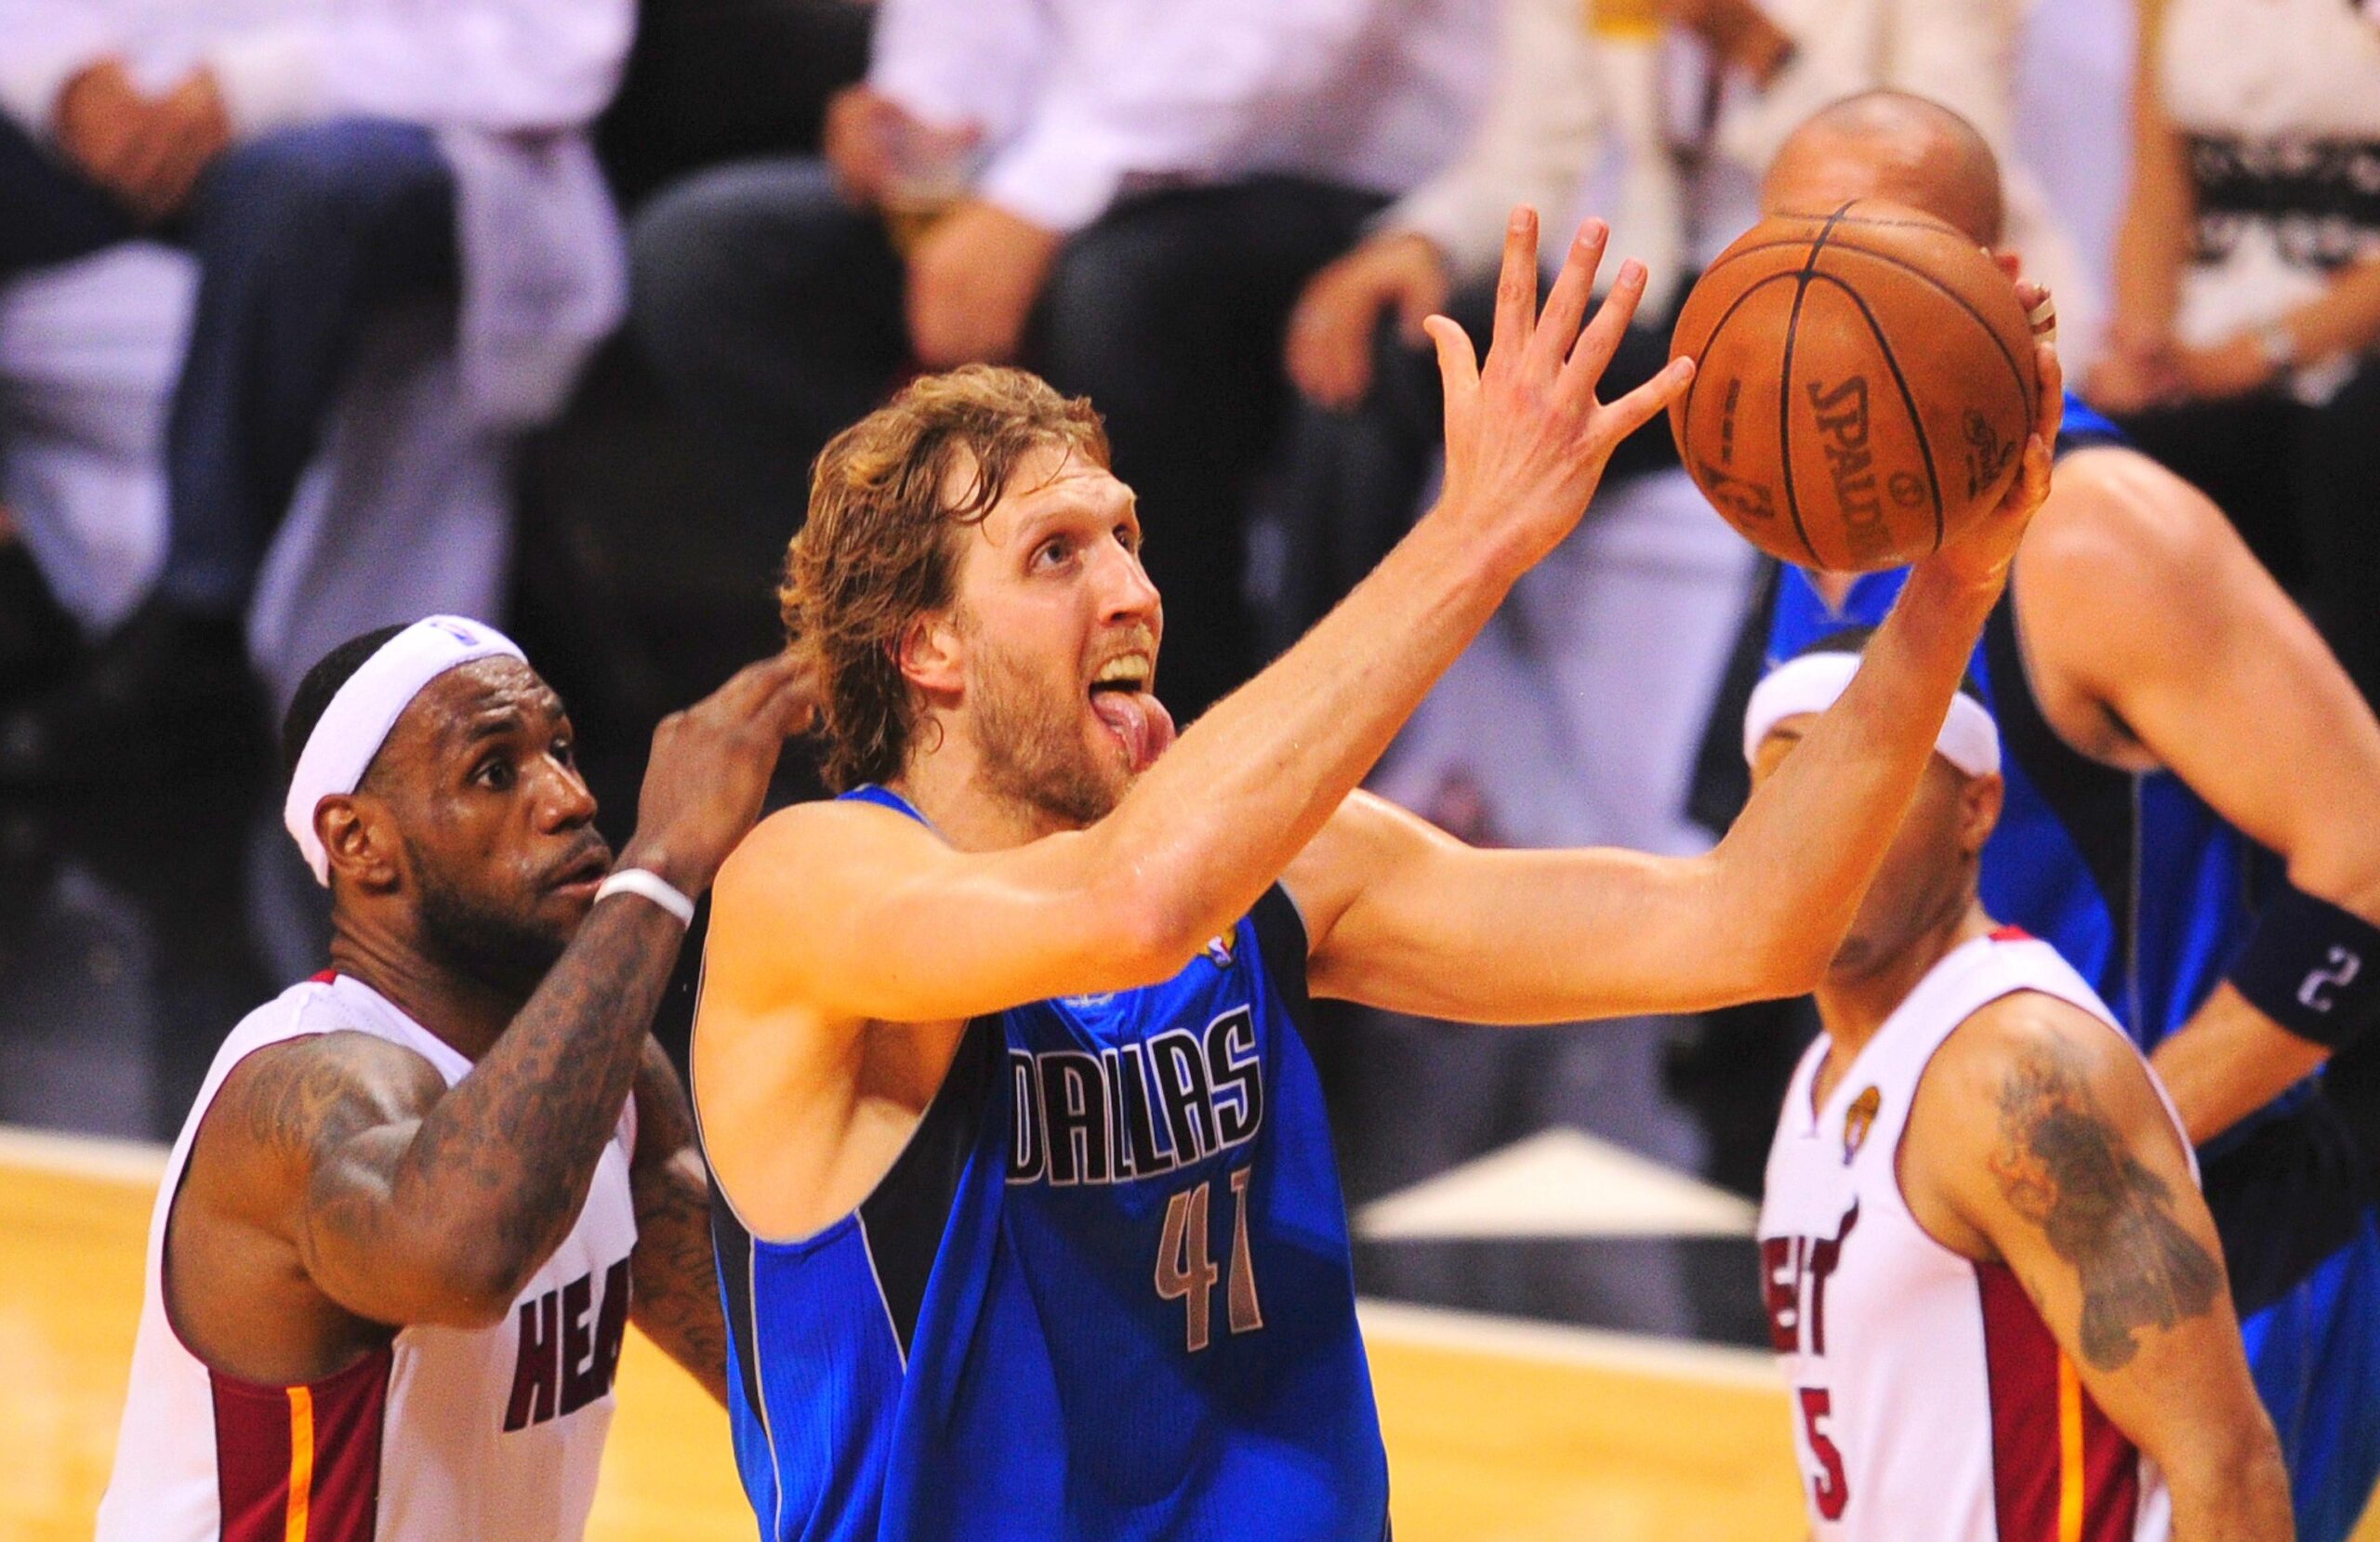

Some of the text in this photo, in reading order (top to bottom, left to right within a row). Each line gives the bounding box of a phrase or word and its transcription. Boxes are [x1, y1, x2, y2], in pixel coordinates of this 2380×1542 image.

[2296, 944, 2360, 1012] 2
[1005, 1004, 1263, 1186] DALLAS
[1154, 1164, 1263, 1352] 41
[1799, 1387, 1849, 1521] 5
